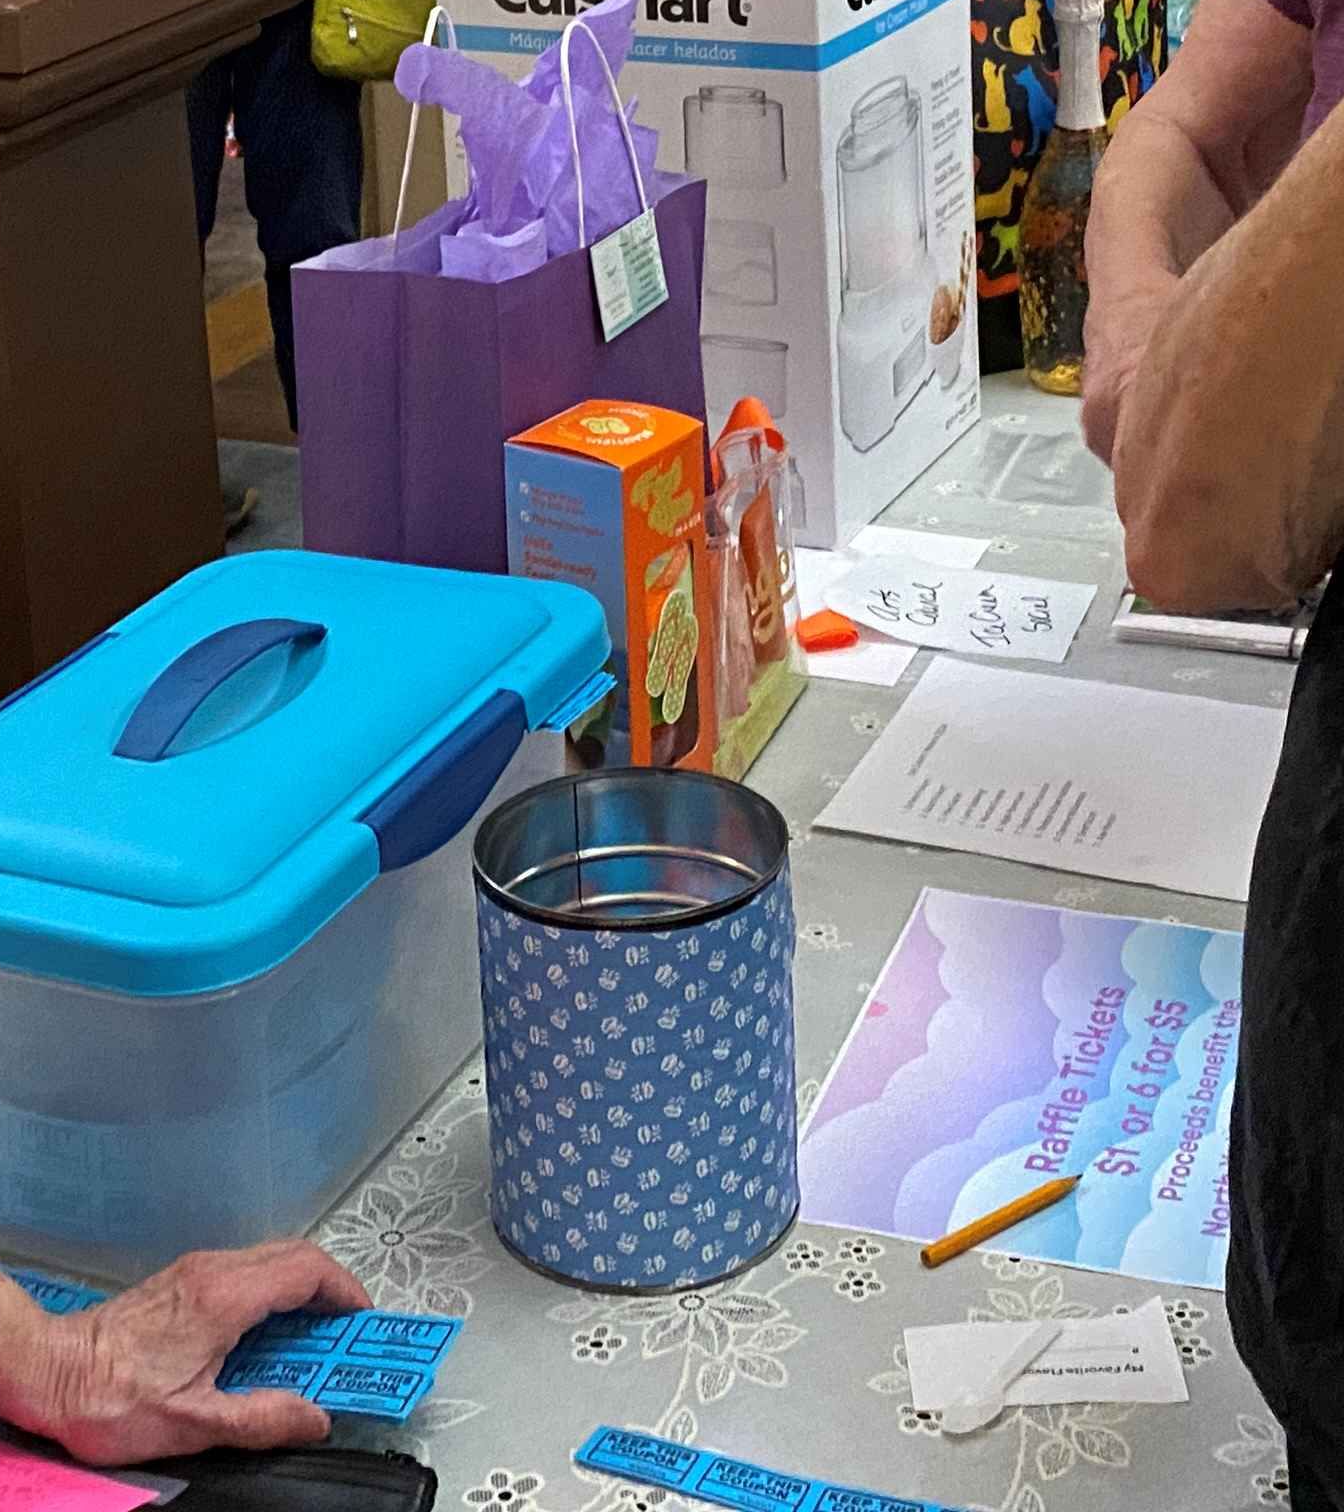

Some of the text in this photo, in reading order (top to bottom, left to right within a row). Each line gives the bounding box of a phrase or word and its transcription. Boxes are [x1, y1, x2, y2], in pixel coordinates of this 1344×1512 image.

[509, 32, 558, 50] Máqu
[673, 40, 737, 62] helados
[1024, 986, 1126, 1173] Raffle Tickets
[1093, 999, 1189, 1177] $1 or 6 for $5
[1157, 999, 1241, 1201] Proceeds benefit the
[375, 1317, 437, 1338] TICKET
[334, 1368, 416, 1388] KEEP THIS
[335, 1378, 400, 1394] COUPON
[607, 1432, 692, 1462] KEEP THIS
[610, 1441, 680, 1468] COUPON
[715, 1462, 803, 1493] KEEP THIS
[718, 1474, 791, 1501] COUPON
[827, 1491, 874, 1507] KEEP
